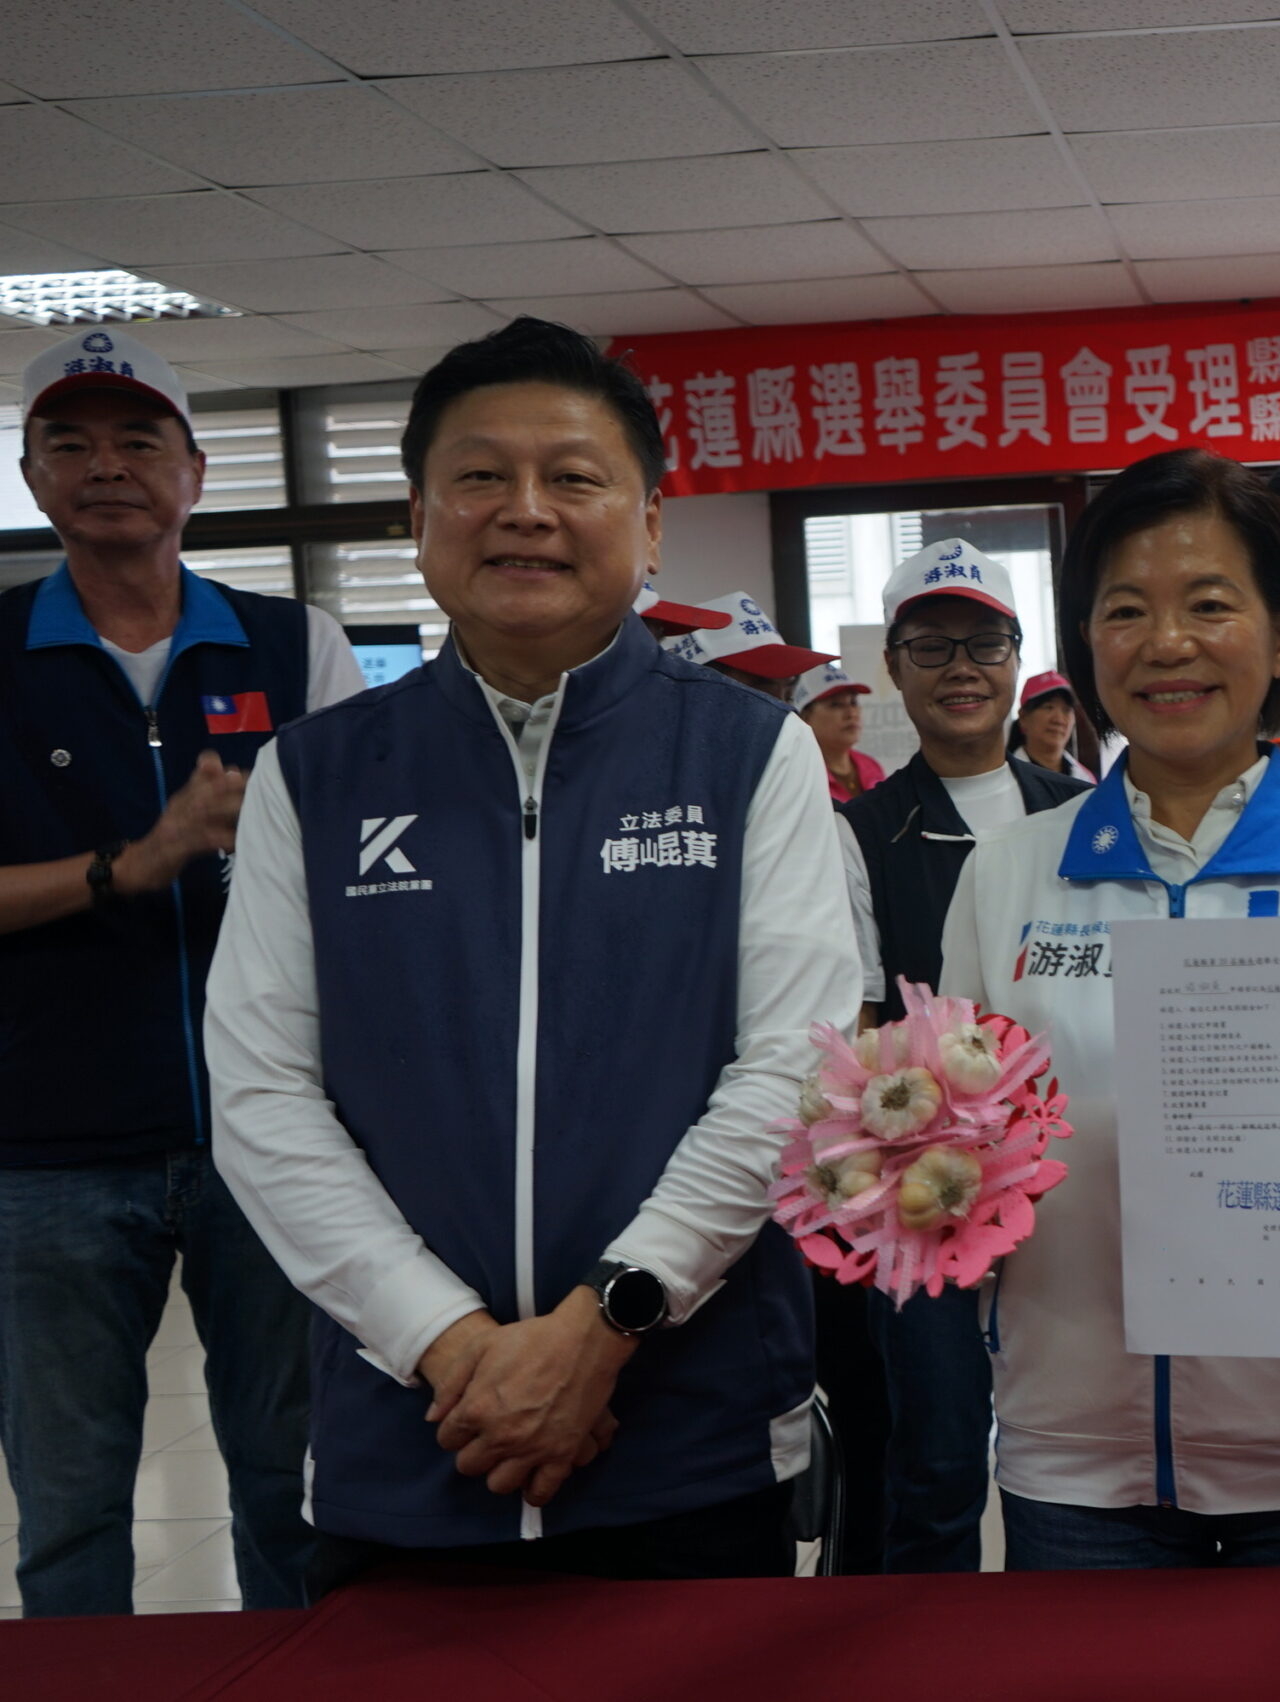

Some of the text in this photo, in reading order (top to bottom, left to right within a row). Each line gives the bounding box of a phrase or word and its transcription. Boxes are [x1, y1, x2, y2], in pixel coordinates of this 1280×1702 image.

[619, 805, 704, 831] 立法委員
[1027, 941, 1112, 977] 游淑
